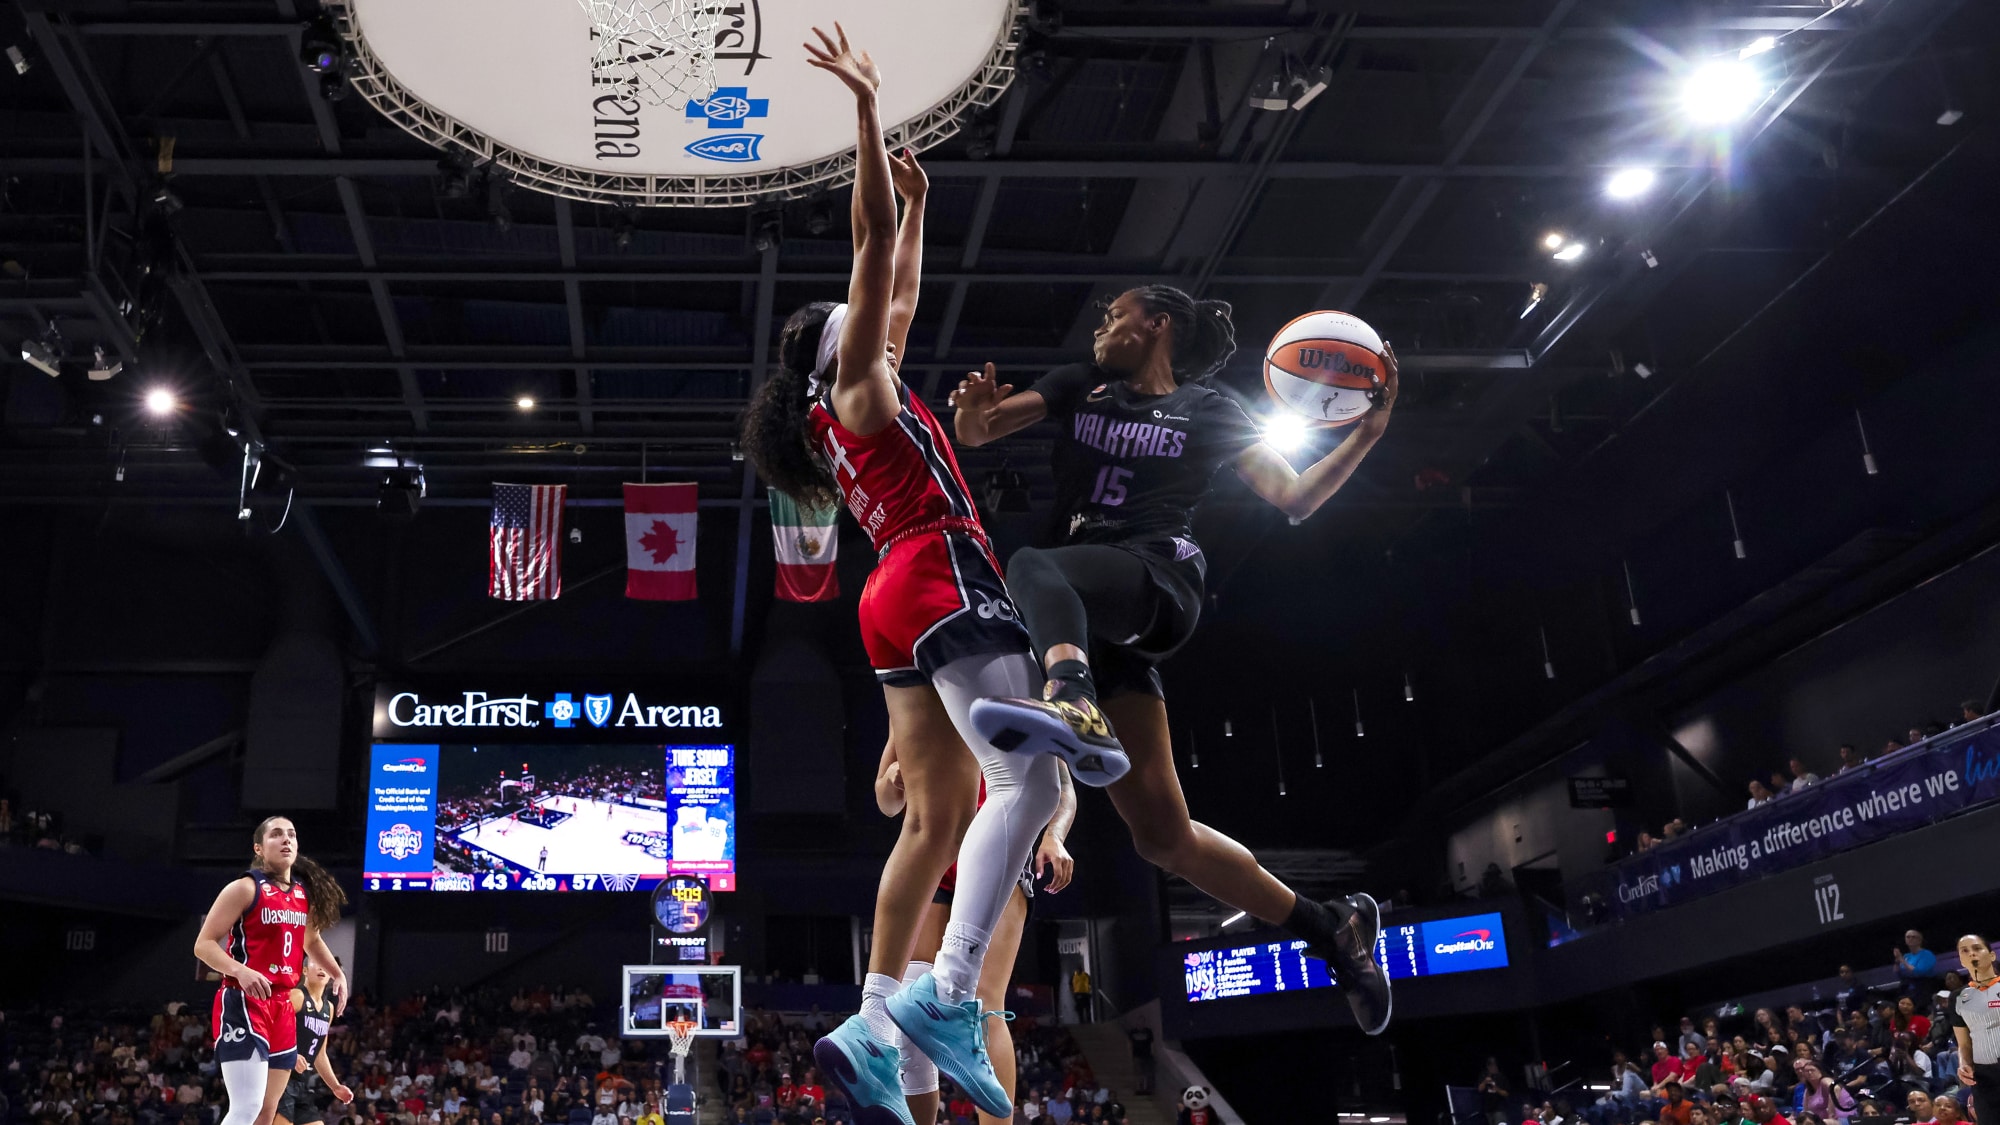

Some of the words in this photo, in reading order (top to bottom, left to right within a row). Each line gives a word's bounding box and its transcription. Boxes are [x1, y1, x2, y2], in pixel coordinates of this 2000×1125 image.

[590, 26, 675, 161] Arena
[1298, 347, 1376, 379] Wilson
[1074, 412, 1187, 459] VALKYRIES
[1090, 465, 1135, 507] 15
[868, 501, 888, 536] AT&T
[388, 691, 540, 728] CareFirst
[615, 692, 723, 728] Arena
[671, 749, 697, 767] TUNE
[696, 749, 729, 769] SQUAD
[682, 767, 718, 786] JERSEY
[374, 787, 385, 796] The
[386, 787, 405, 796] Official
[405, 787, 419, 796] Bank
[419, 787, 431, 796] and
[378, 796, 395, 804] Credit
[396, 796, 409, 804] Card
[409, 796, 416, 804] of
[416, 796, 426, 804] the
[374, 803, 408, 813] Washington
[408, 803, 429, 813] Mystics
[1690, 843, 1749, 879] Making
[1750, 840, 1762, 859] a
[1763, 807, 1855, 855] difference
[1856, 782, 1923, 822] where
[1924, 769, 1960, 798] we
[371, 879, 380, 891] 3
[392, 879, 402, 891] 2
[482, 874, 508, 890] 43
[521, 877, 557, 891] 4:09
[572, 874, 598, 890] 57
[671, 887, 703, 902] 4:09
[1814, 883, 1845, 925] 112
[683, 901, 699, 928] 5
[65, 929, 96, 951] 109
[283, 931, 293, 958] 8
[485, 932, 509, 953] 110
[671, 937, 707, 946] TISSOT
[1231, 946, 1256, 958] PLAYER
[1268, 943, 1281, 953] PTS
[1401, 925, 1415, 935] FLS
[1273, 952, 1279, 960] 7
[1379, 939, 1385, 947] 2
[1407, 935, 1413, 944] 2
[1275, 967, 1281, 975] 0
[1301, 964, 1307, 972] 0
[1381, 955, 1387, 963] 0
[1409, 951, 1415, 960] 0
[1300, 957, 1306, 965] 0
[1380, 947, 1386, 955] 0
[1408, 943, 1414, 951] 4
[1411, 959, 1416, 967] 1
[1275, 982, 1285, 990] 10
[1303, 980, 1309, 988] 1
[1412, 967, 1417, 976] 1
[308, 1038, 319, 1056] 2
